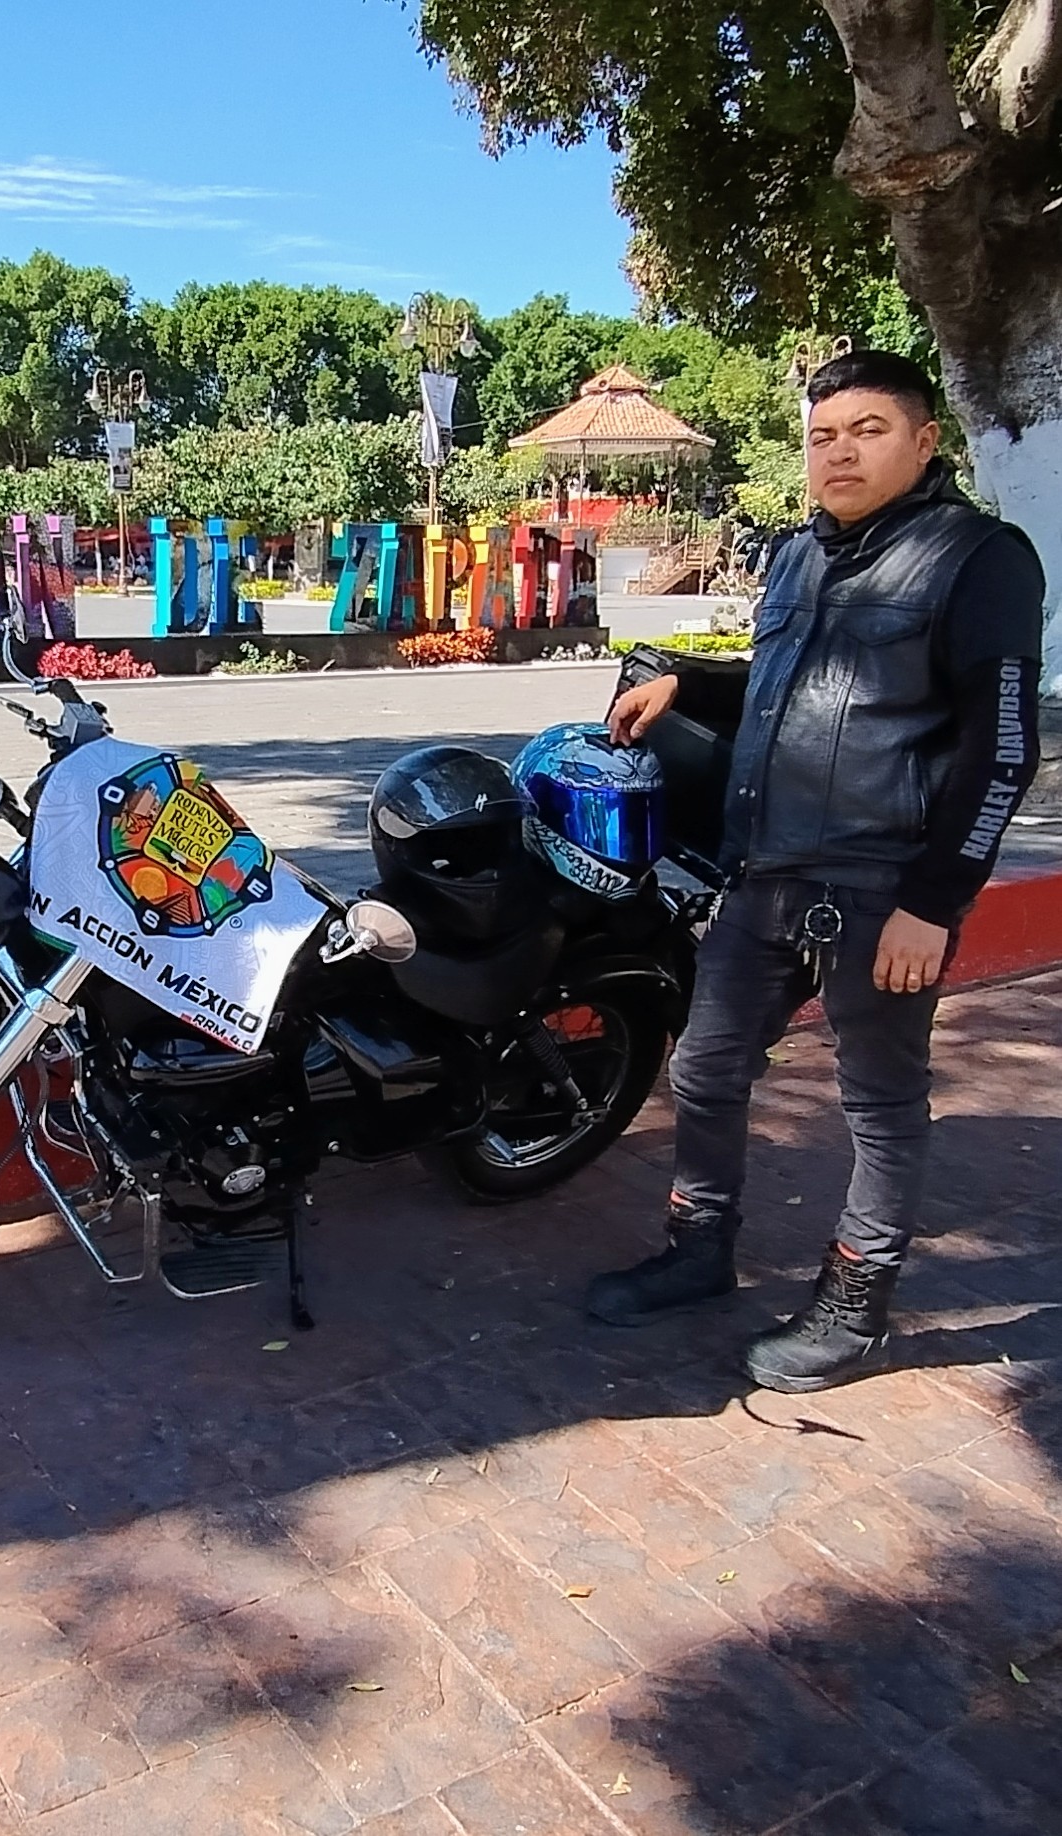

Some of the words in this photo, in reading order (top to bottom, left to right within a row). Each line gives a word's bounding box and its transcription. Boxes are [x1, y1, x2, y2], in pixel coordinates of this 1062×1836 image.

[959, 779, 1019, 861] HARLEY
[31, 885, 52, 916] N
[56, 905, 154, 971] ACCIÓN
[156, 963, 262, 1034] MÉXICO
[192, 1013, 227, 1038] RRM
